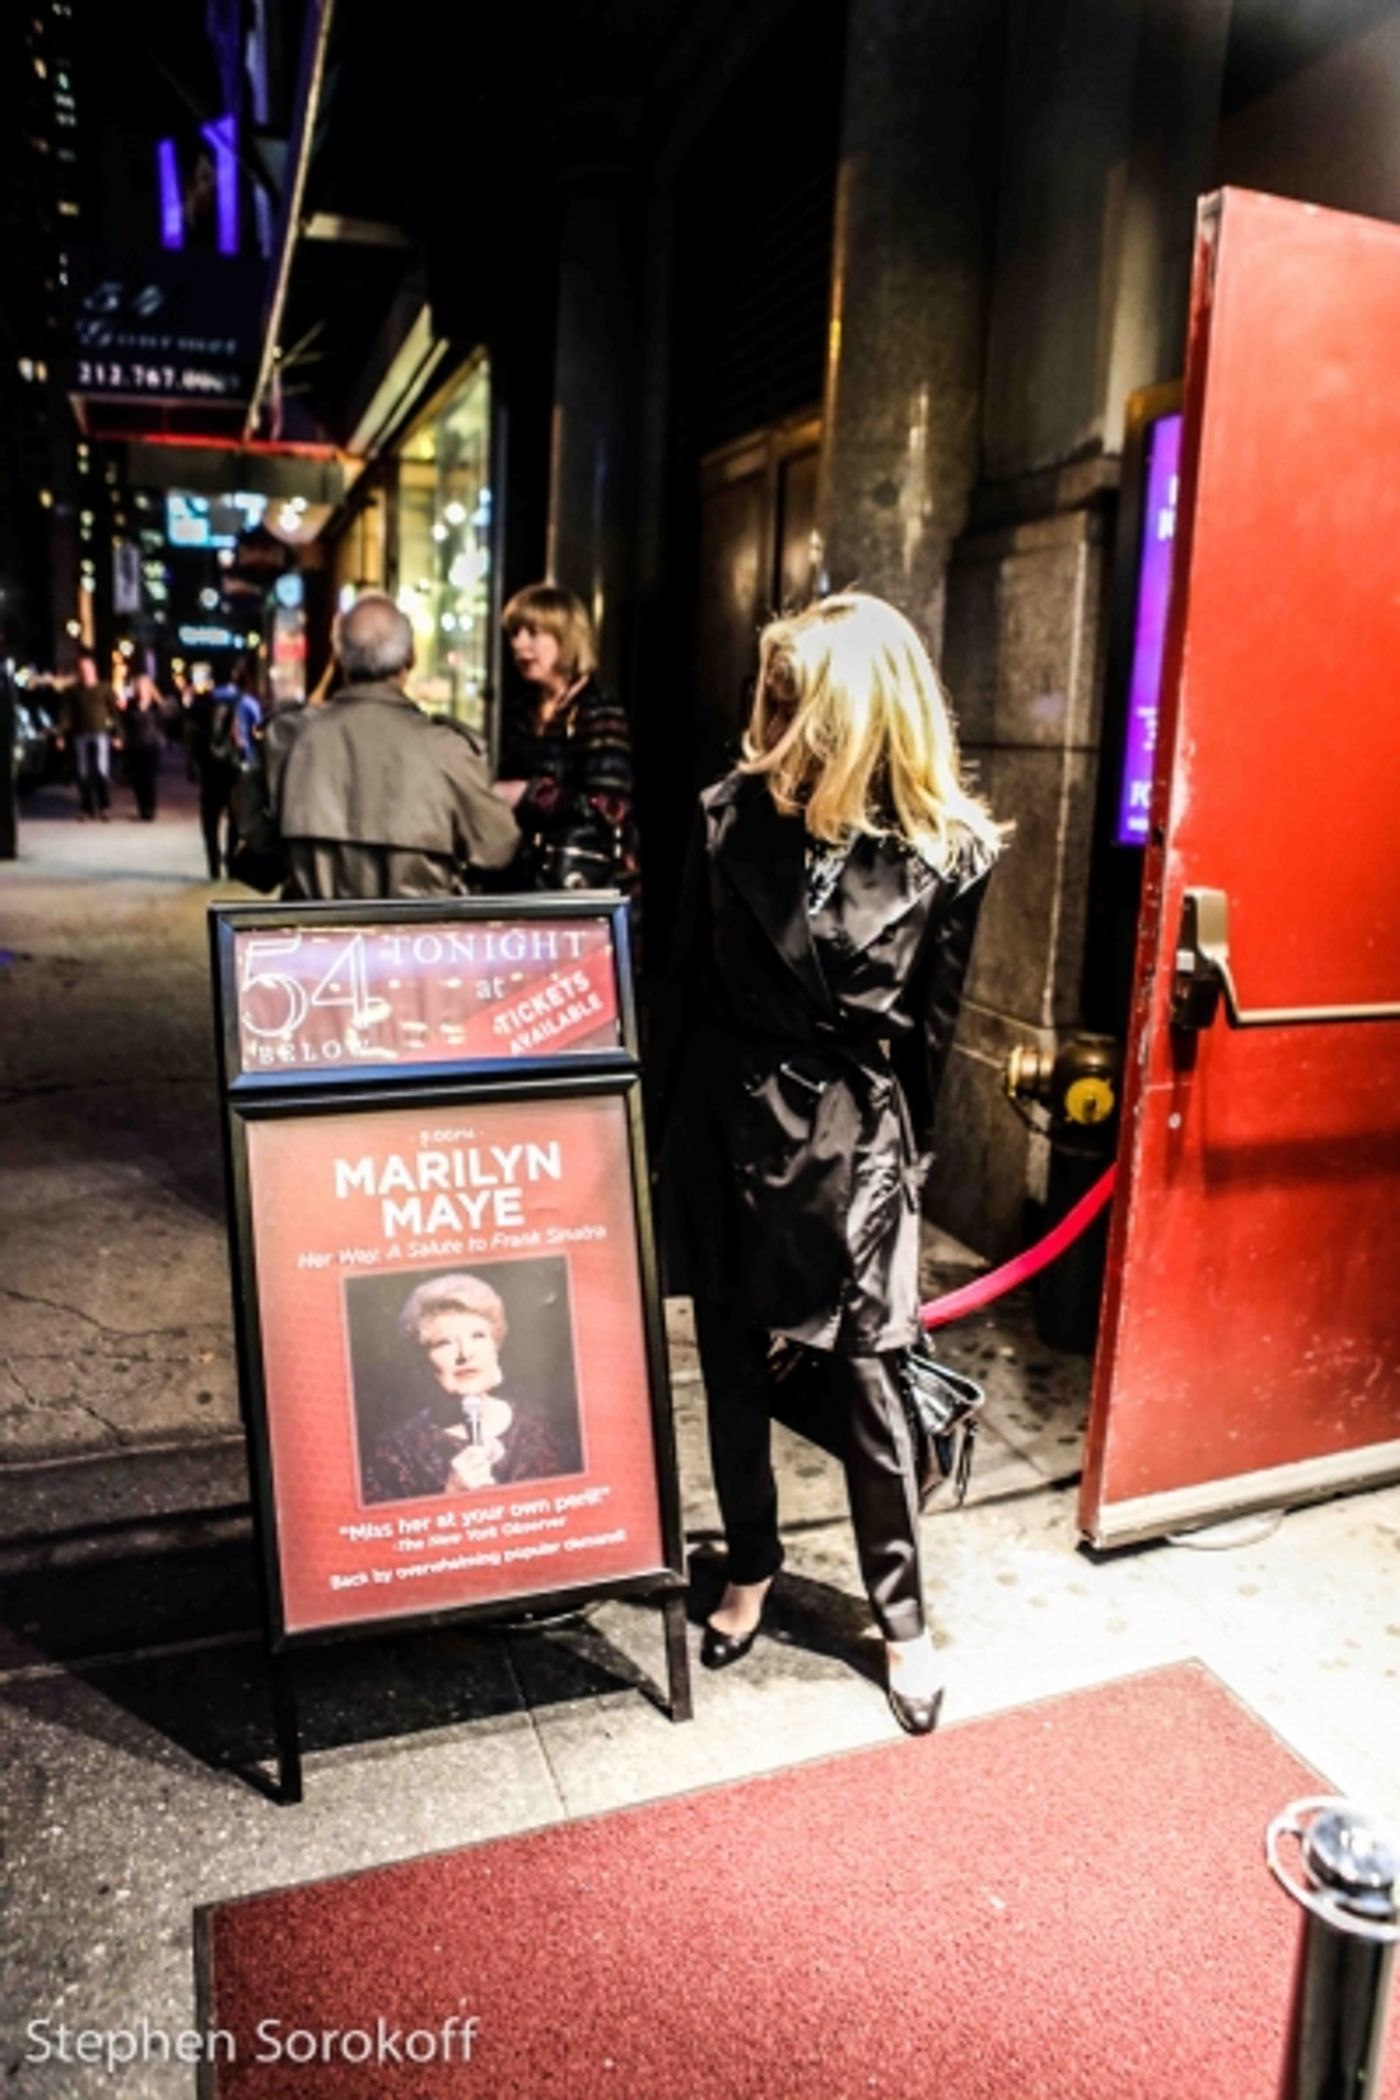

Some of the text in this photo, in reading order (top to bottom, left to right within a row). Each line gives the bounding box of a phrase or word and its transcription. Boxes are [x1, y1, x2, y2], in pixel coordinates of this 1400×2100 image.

[383, 930, 587, 964] TONIGHT
[242, 932, 383, 1037] 54
[476, 976, 505, 998] at
[493, 969, 591, 1036] TICKETS
[510, 993, 604, 1057] AVAILABLE
[333, 1140, 562, 1200] MARILYN
[381, 1186, 526, 1238] MAYE
[297, 1250, 333, 1269] Her
[386, 1242, 402, 1260] A
[408, 1238, 463, 1258] Salute
[468, 1236, 487, 1252] to
[491, 1230, 542, 1249] Frank
[546, 1225, 607, 1245] Sinatra
[399, 1516, 432, 1534] her
[436, 1511, 456, 1528] at
[461, 1504, 506, 1526] your
[511, 1498, 551, 1518] own
[428, 1532, 463, 1549] New
[466, 1526, 498, 1542] York
[501, 1515, 567, 1536] Observer
[329, 1572, 369, 1591] Back
[372, 1567, 393, 1584] by
[504, 1540, 561, 1563] popular
